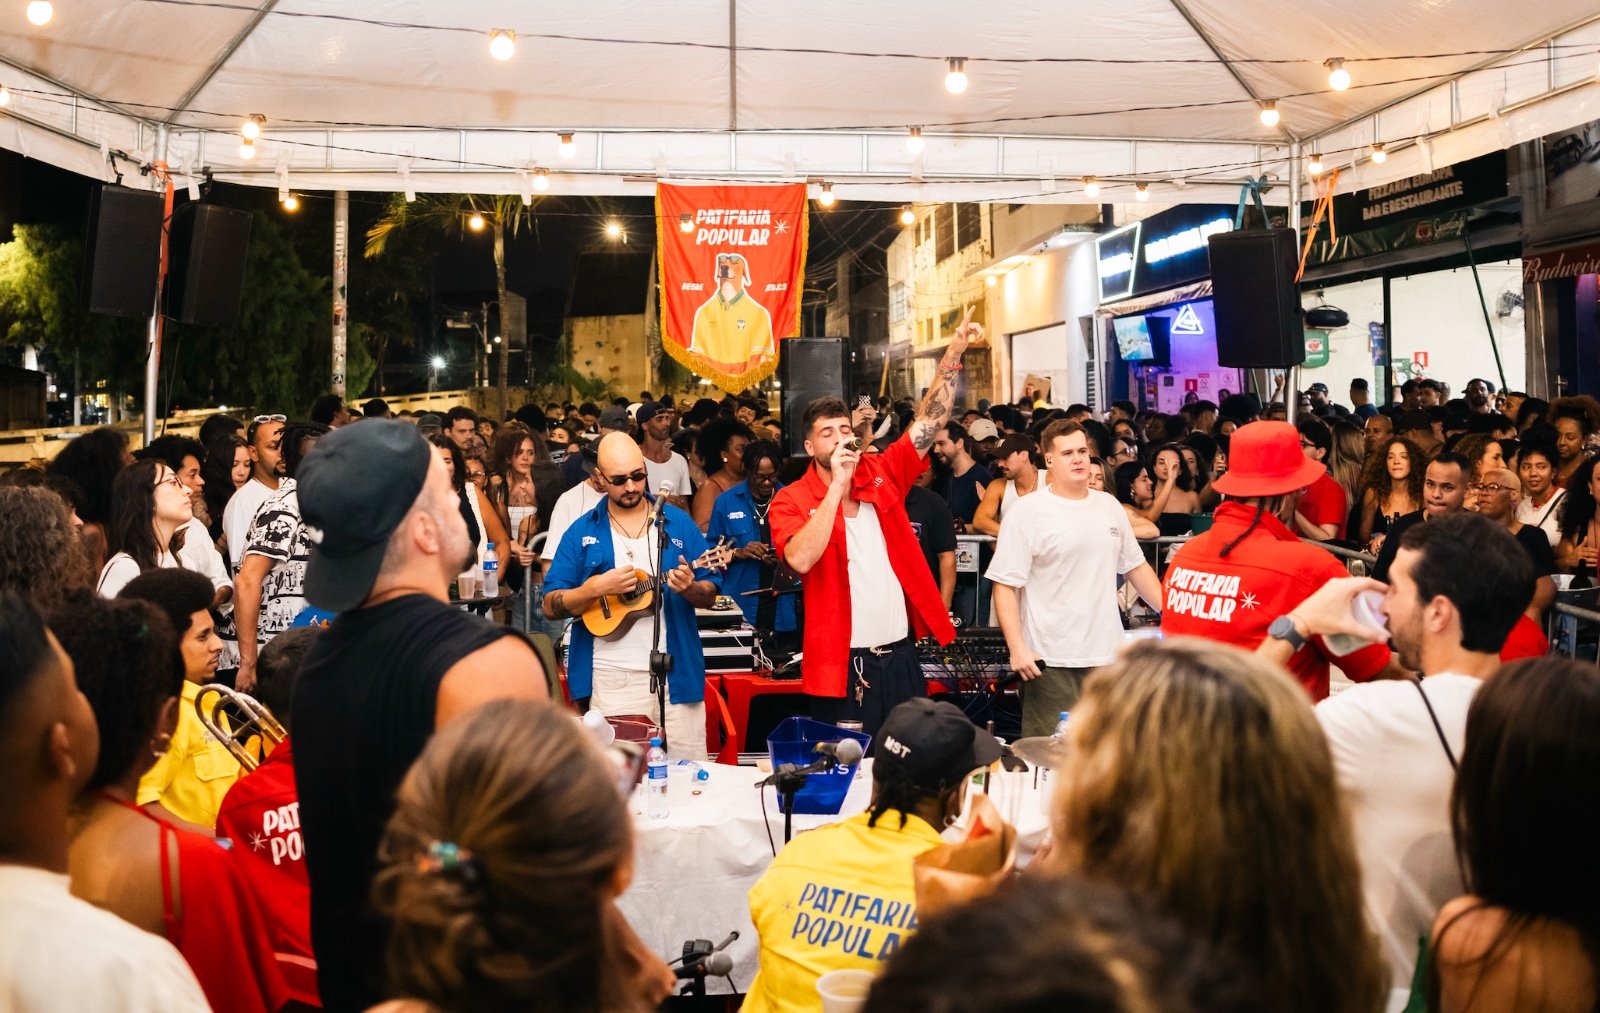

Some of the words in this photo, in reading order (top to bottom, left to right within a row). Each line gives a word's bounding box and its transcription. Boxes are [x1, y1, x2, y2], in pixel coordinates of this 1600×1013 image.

[1362, 203, 1381, 220] BAR
[1381, 202, 1389, 216] E
[1389, 181, 1463, 213] RESTAURANTE
[695, 209, 771, 225] PATIFARIA
[695, 228, 771, 246] POPULAR
[1169, 566, 1241, 598] PATIFARIA
[1166, 588, 1237, 623] POPULAR
[884, 735, 912, 758] MST
